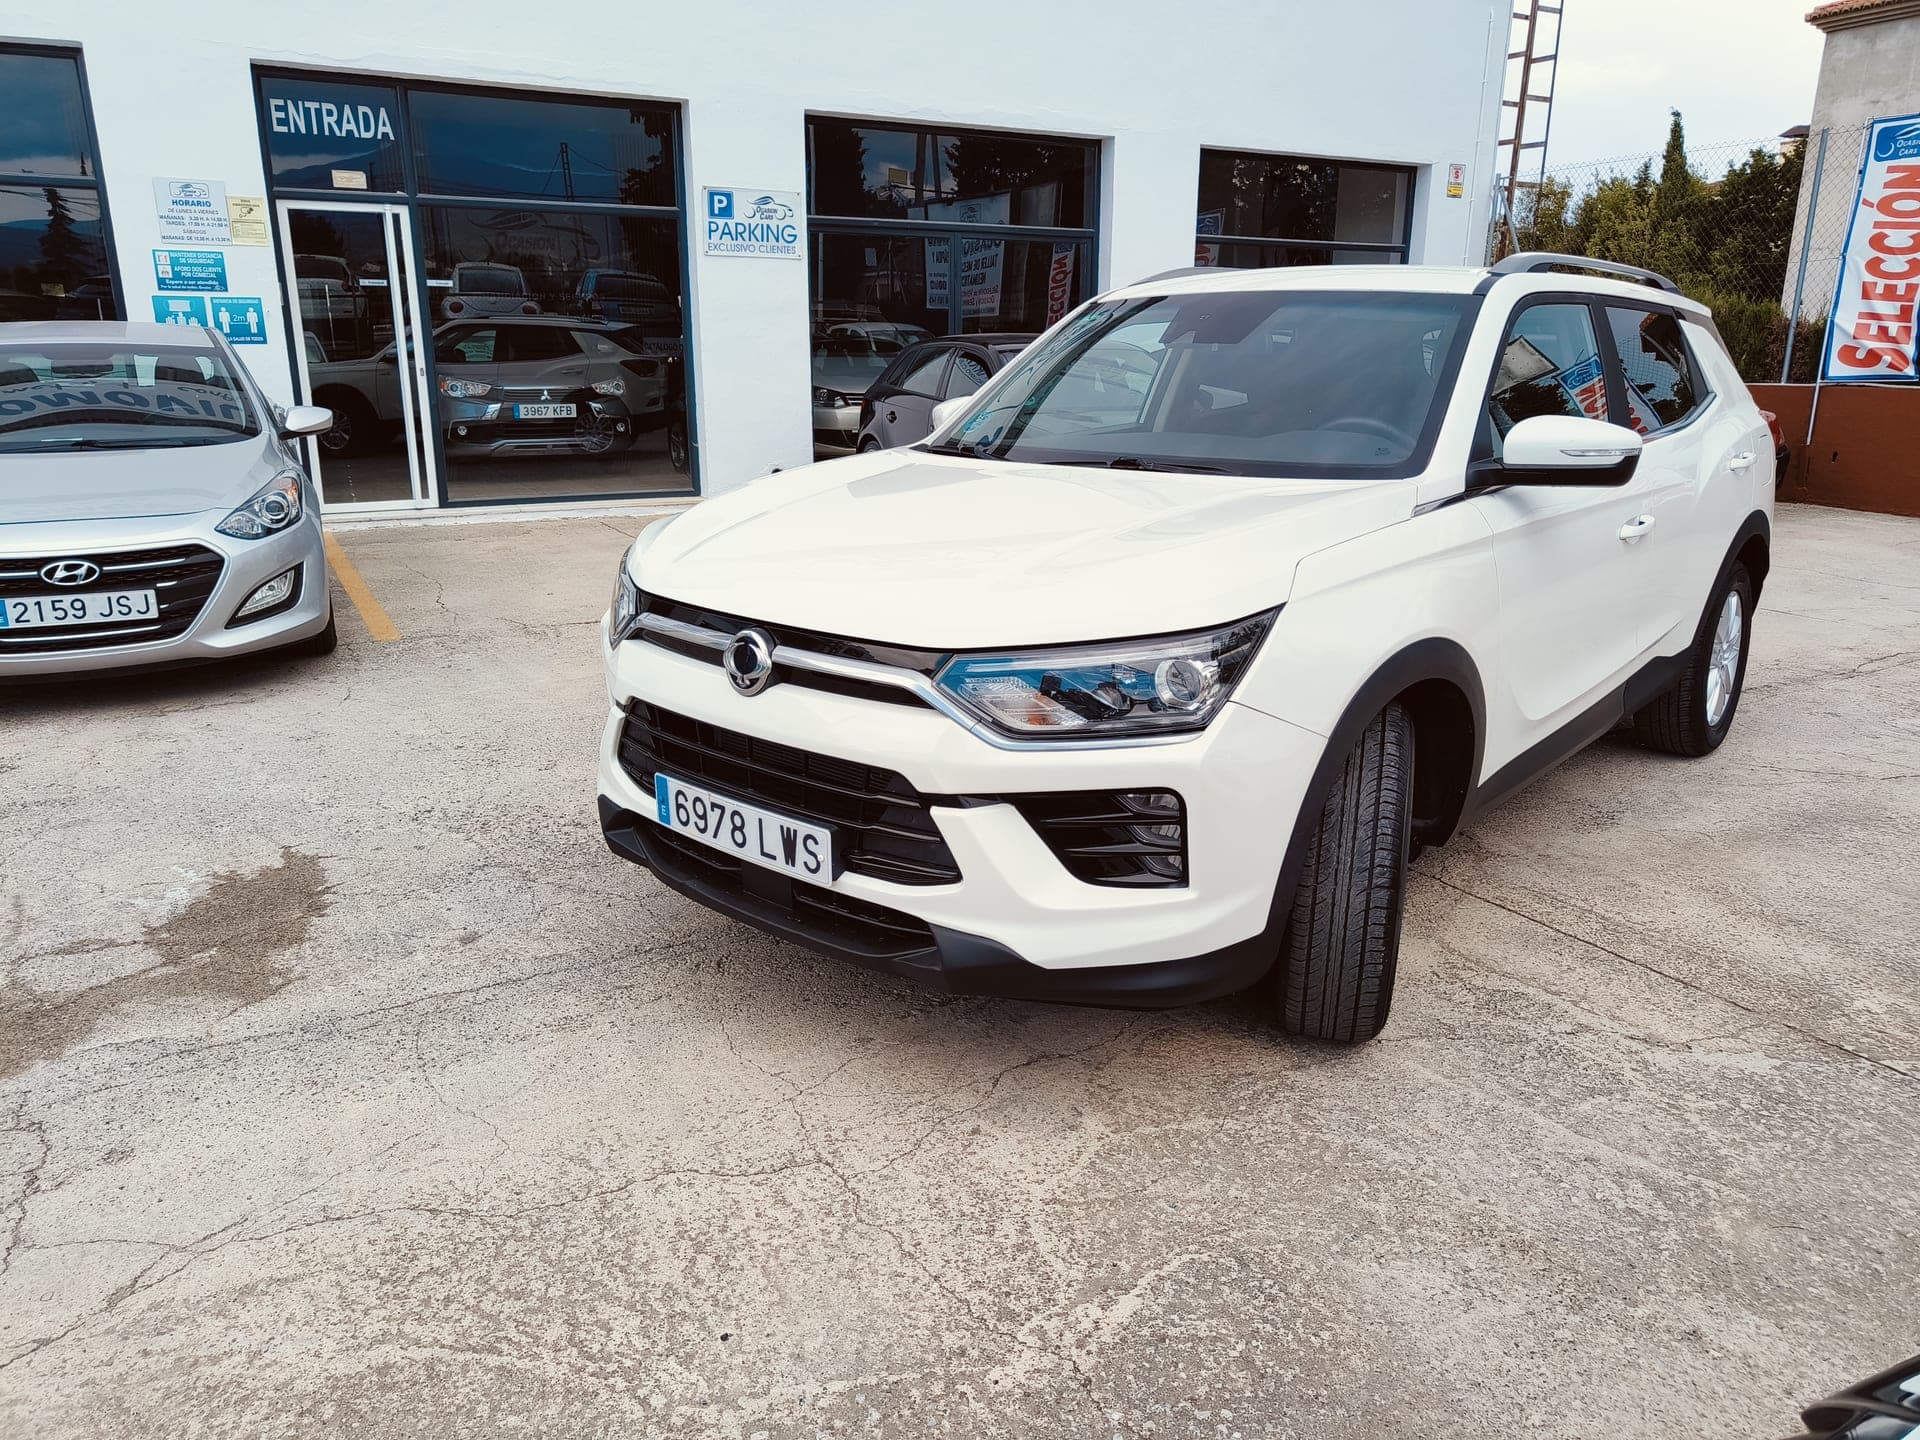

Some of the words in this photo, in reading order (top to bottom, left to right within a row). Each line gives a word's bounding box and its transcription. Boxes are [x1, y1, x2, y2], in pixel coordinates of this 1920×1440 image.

[269, 98, 395, 140] ENTRADA
[172, 199, 211, 207] HORARIO
[714, 195, 728, 214] P
[708, 221, 798, 244] PARKING
[708, 243, 756, 253] EXCLUSIVO
[759, 245, 797, 254] CLIENTES
[1837, 165, 1920, 372] SELECCIÓN
[232, 314, 246, 322] 2m
[523, 406, 550, 416] 3967
[552, 406, 572, 416] KFB
[13, 598, 87, 624] 2159
[100, 594, 151, 618] JSJ
[674, 789, 747, 849] 6978
[758, 817, 821, 875] LWS
